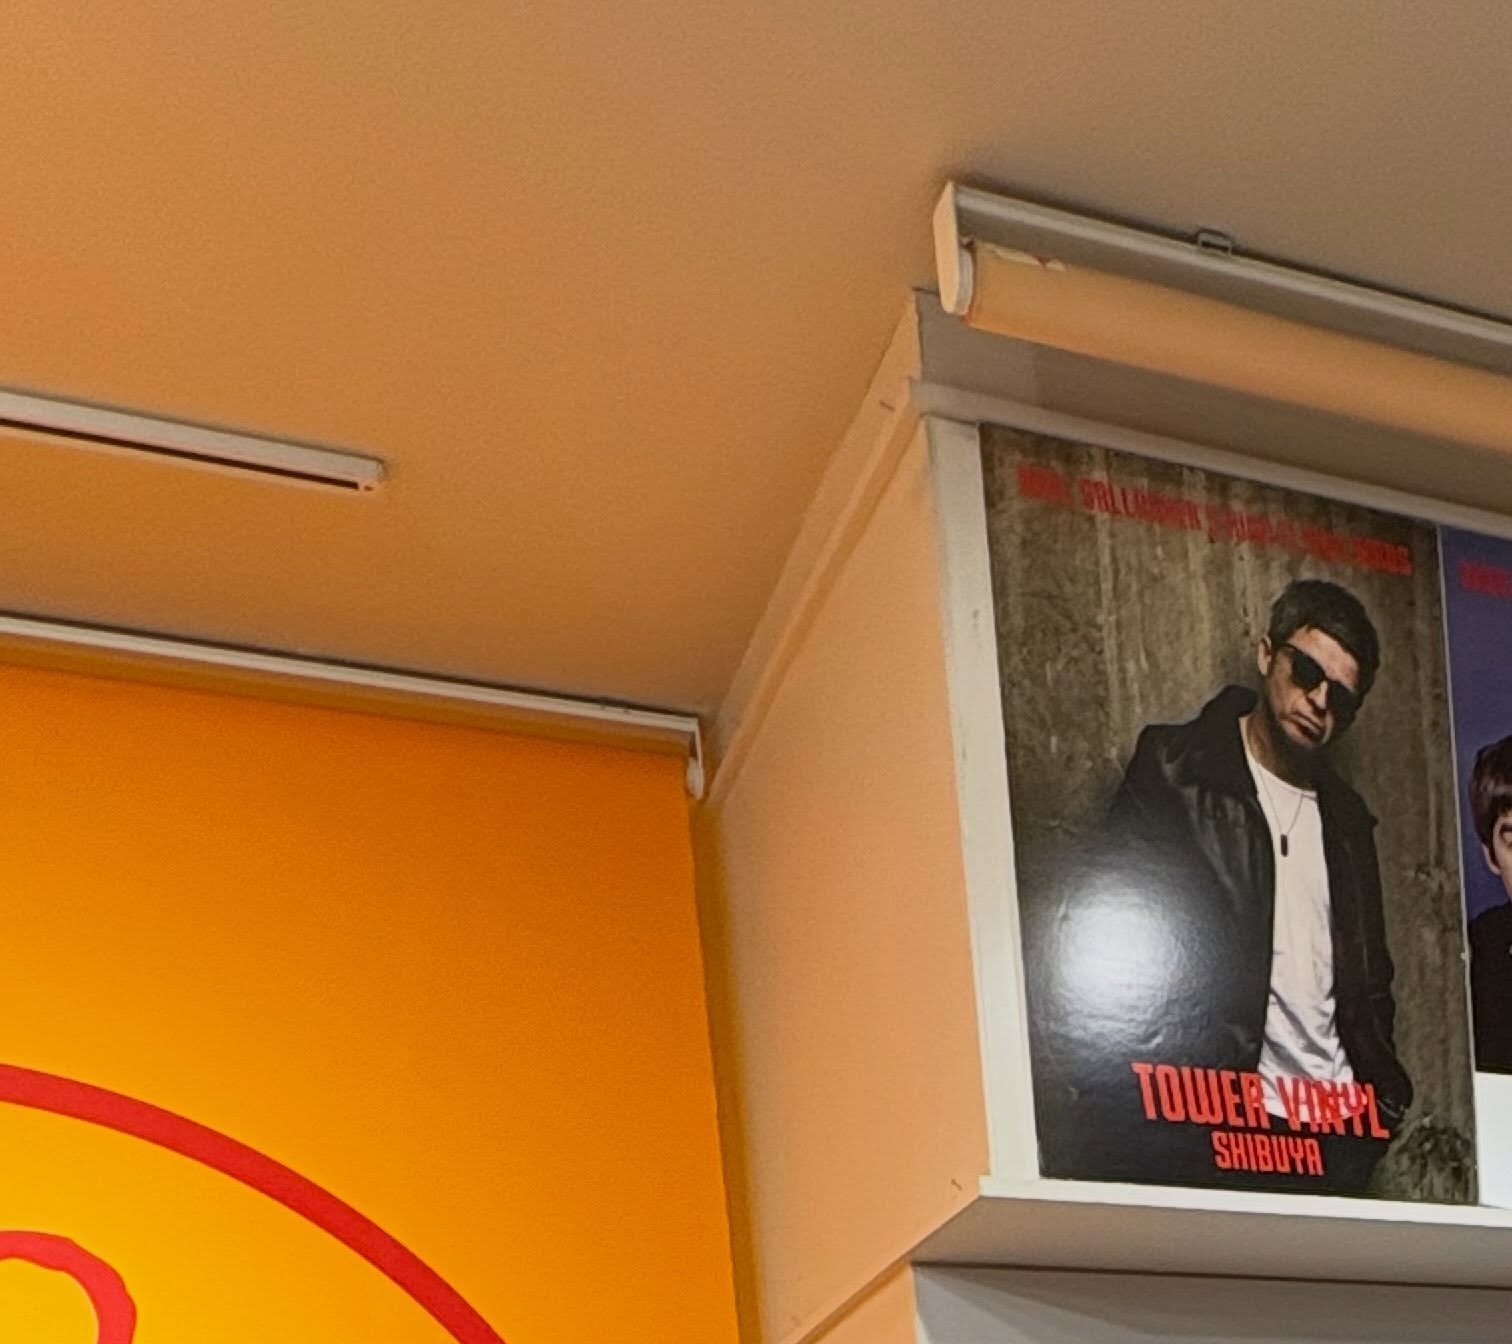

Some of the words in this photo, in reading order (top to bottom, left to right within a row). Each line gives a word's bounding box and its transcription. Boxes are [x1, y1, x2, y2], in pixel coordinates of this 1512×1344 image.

[1131, 1062, 1272, 1130] TOWER
[1275, 1076, 1391, 1140] VINYL
[1210, 1129, 1325, 1177] SHIBUYA
